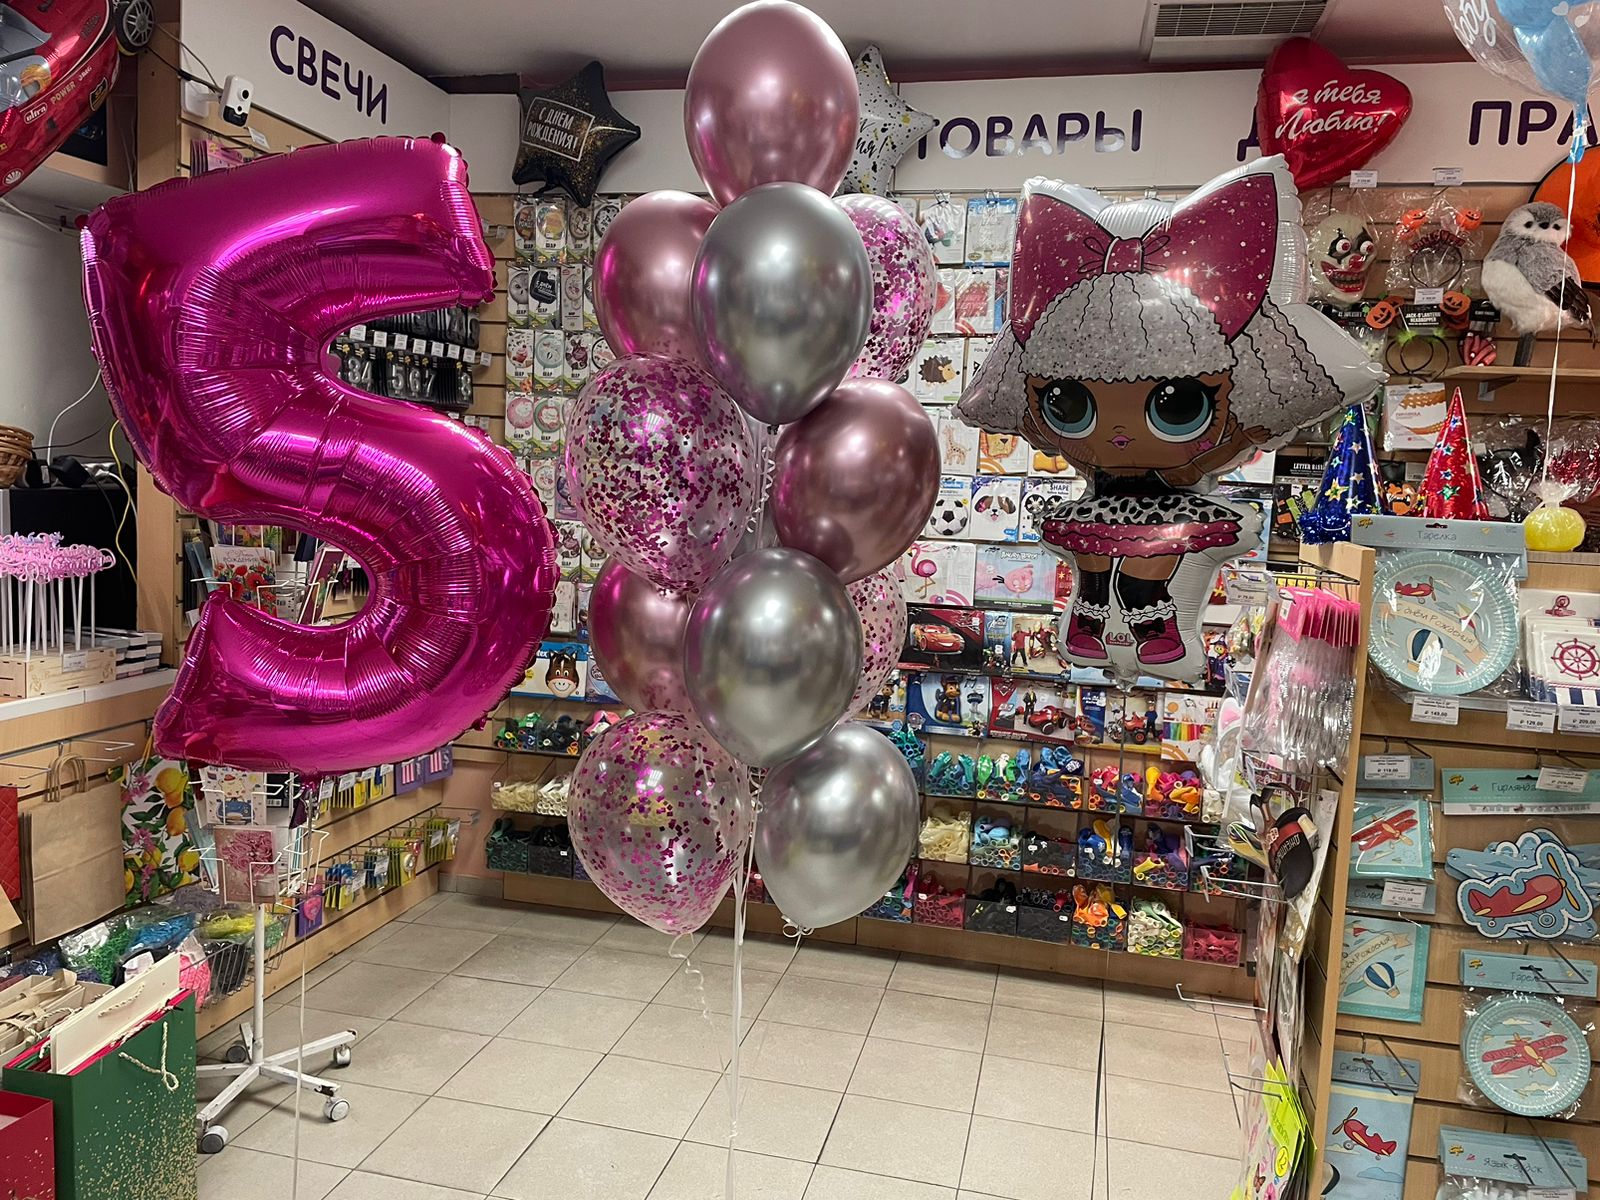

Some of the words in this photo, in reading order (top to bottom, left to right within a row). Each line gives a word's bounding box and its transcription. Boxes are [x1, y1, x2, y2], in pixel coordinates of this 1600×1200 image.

[269, 24, 388, 125] СВЕЧИ
[50, 81, 77, 105] POWER
[1313, 80, 1381, 105] тебя
[526, 121, 579, 152] РОЖДЕНИЯ!
[1275, 108, 1389, 140] Люблю!
[1417, 531, 1457, 542] Тарелка
